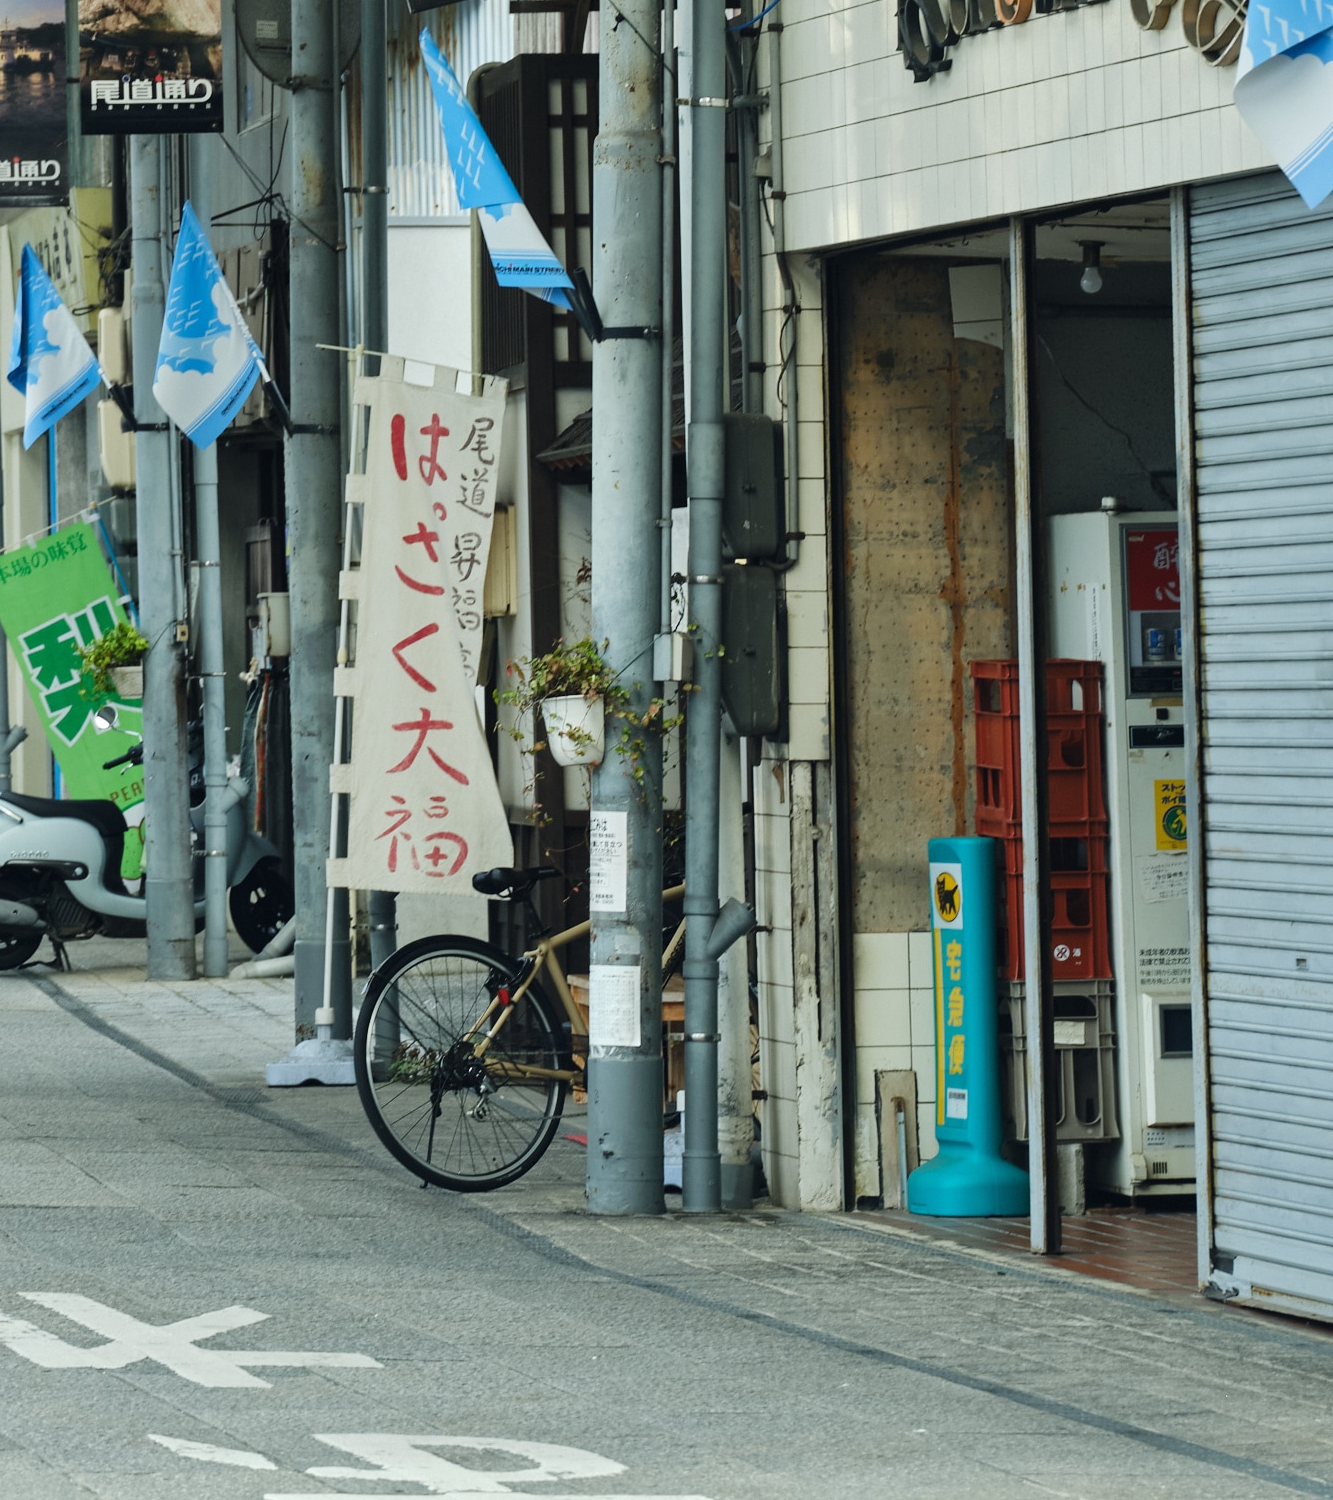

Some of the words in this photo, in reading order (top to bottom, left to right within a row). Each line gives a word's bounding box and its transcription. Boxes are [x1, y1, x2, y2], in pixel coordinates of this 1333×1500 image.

[90, 74, 212, 105] 尾道通り
[374, 413, 470, 879] はっさく大福
[109, 778, 144, 802] PEA
[946, 938, 966, 1076] 宅急便
